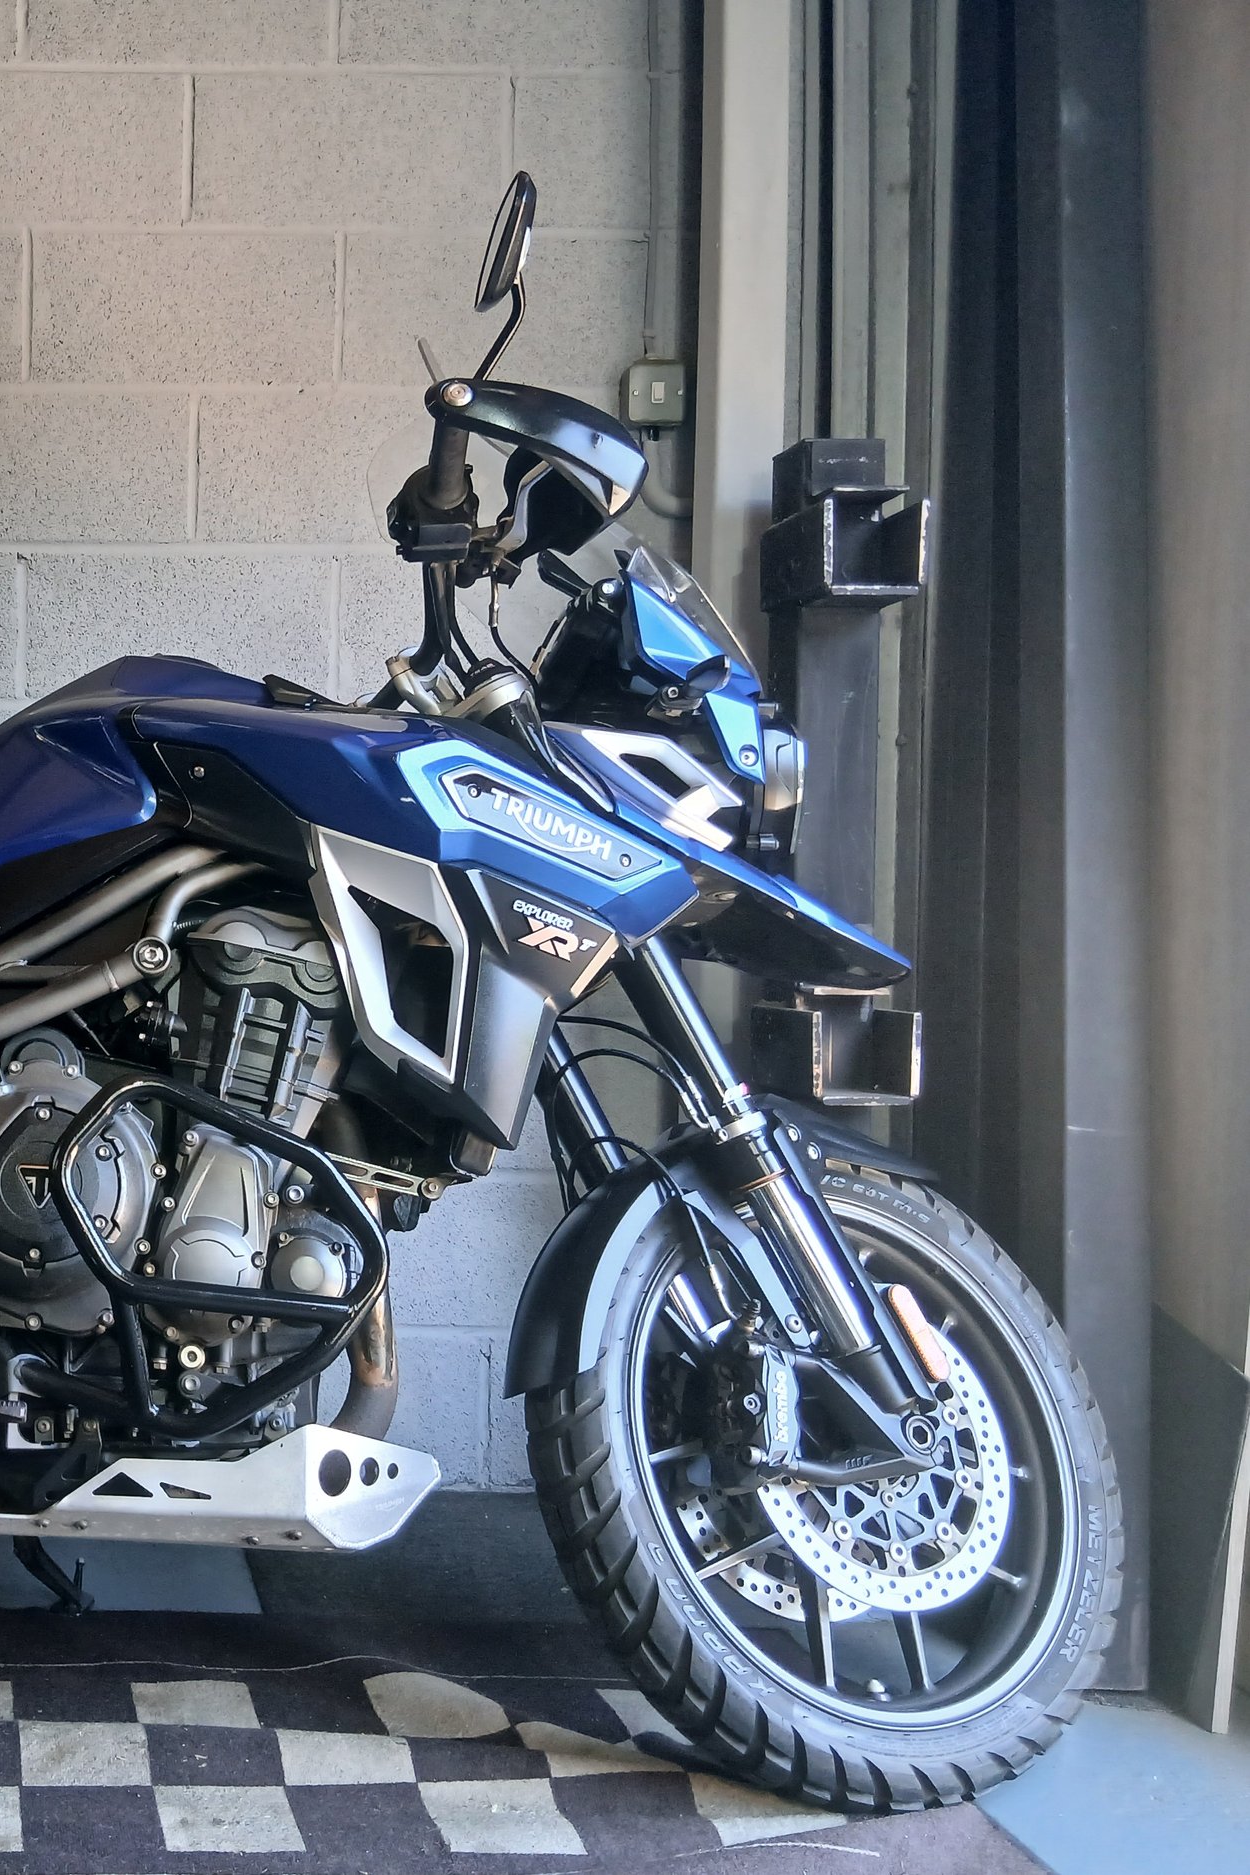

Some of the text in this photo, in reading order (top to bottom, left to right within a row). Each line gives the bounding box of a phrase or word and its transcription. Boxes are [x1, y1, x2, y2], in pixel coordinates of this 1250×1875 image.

[490, 787, 613, 861] TRIUMPH
[513, 899, 574, 931] EXPLORER
[773, 1370, 789, 1444] brembo
[1059, 1504, 1103, 1663] METZELER
